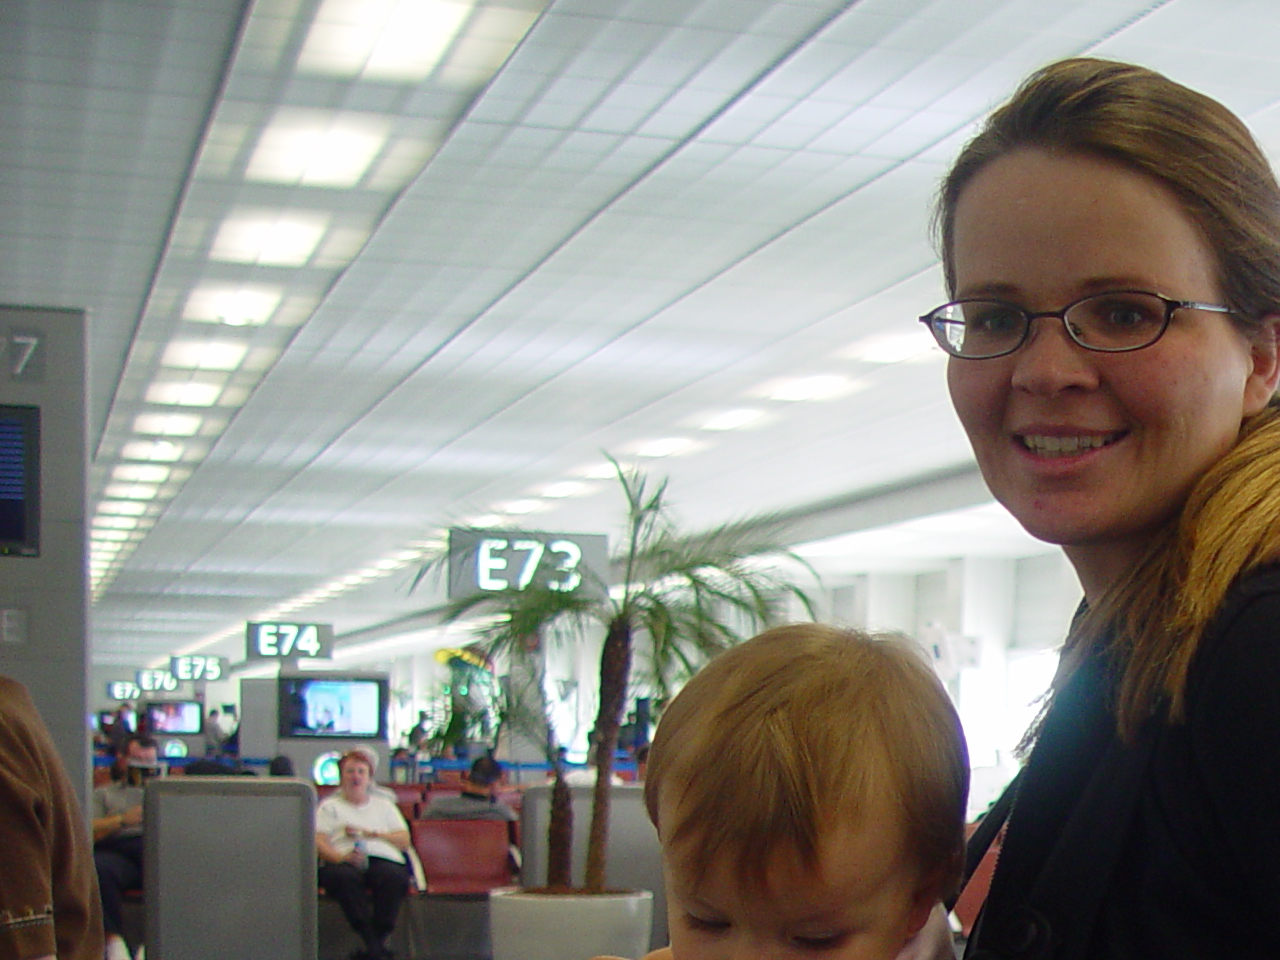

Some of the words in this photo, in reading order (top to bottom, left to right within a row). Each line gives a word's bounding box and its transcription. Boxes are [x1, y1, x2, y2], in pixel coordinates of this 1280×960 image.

[478, 538, 582, 592] E73
[257, 623, 321, 656] E74
[142, 669, 178, 691] E76
[178, 656, 221, 680] E75
